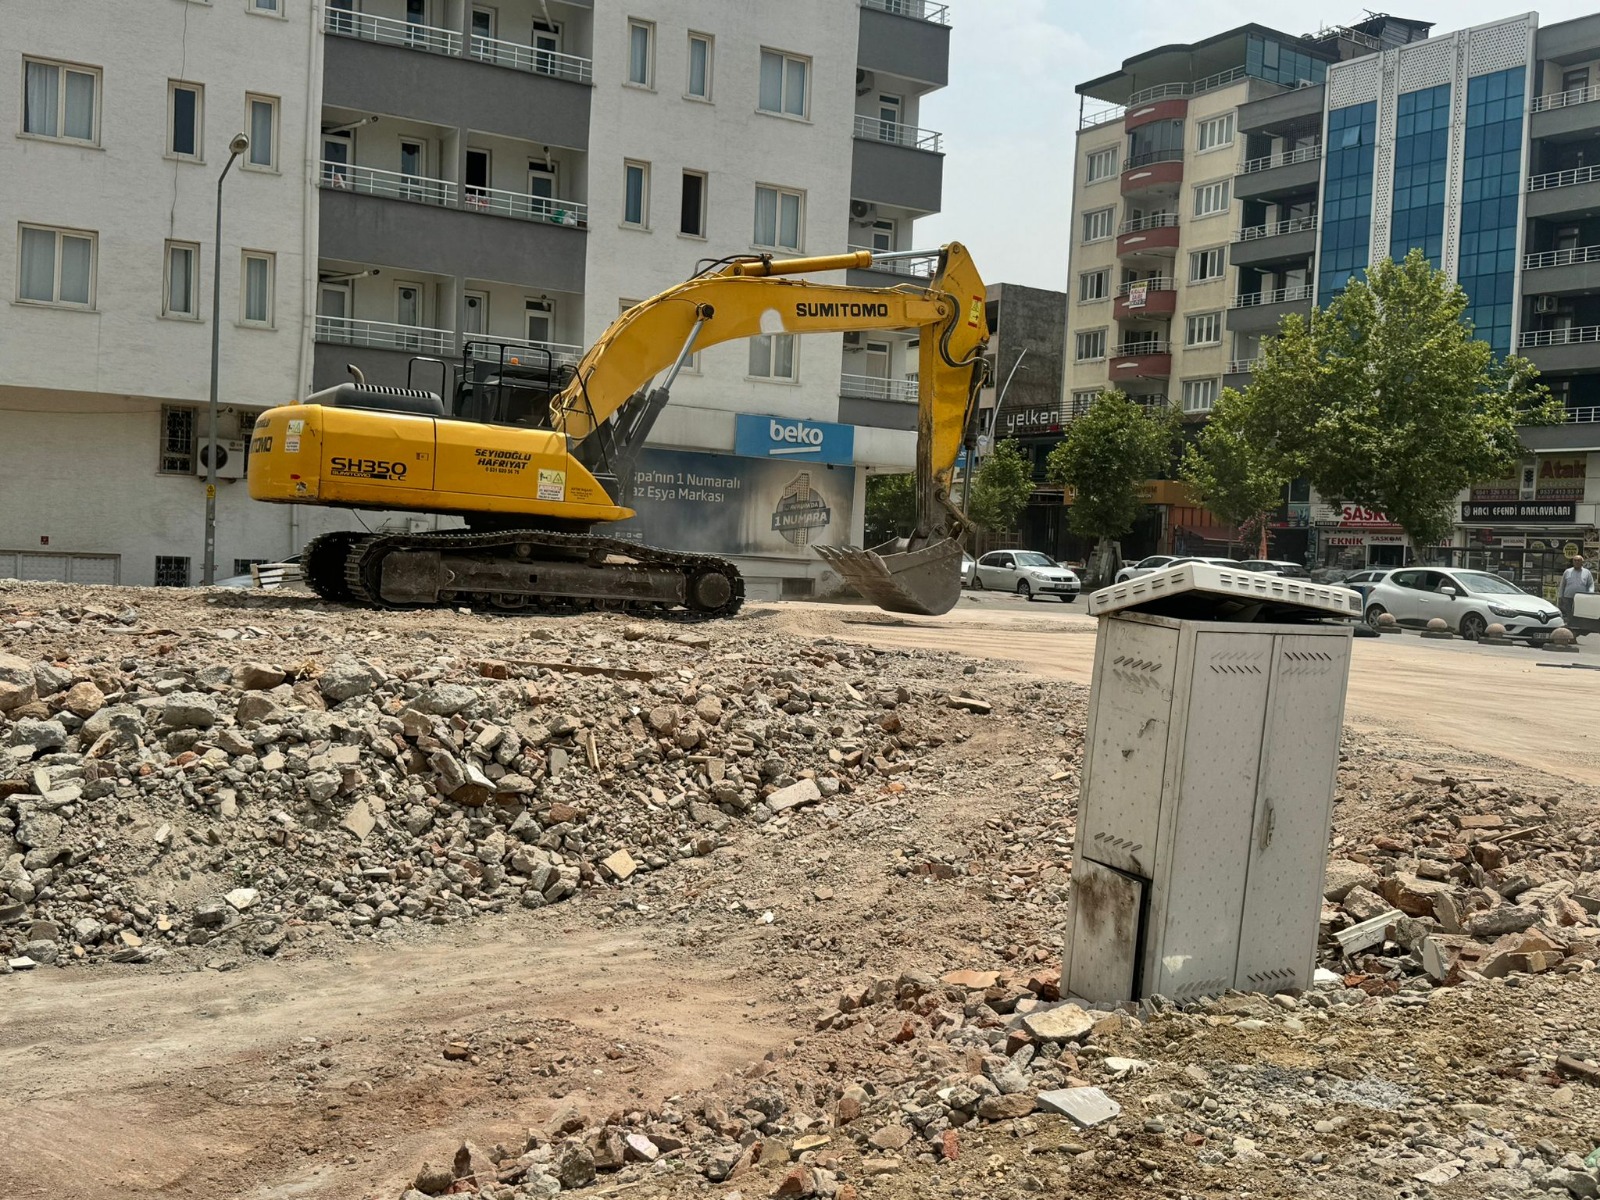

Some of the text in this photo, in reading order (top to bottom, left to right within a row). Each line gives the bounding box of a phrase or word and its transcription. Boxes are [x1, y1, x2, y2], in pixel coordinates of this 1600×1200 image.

[796, 302, 888, 317] SUMITOMO
[1006, 409, 1059, 433] yelken
[769, 419, 824, 445] beko
[331, 457, 407, 475] SH350
[1540, 460, 1586, 479] Atak
[634, 470, 740, 489] pa'nın 1 Numaralı
[647, 486, 675, 501] Eşya
[678, 488, 724, 503] Markası
[774, 511, 828, 526] 1 NUMARA
[1473, 505, 1571, 516] HACI EFENDİ BAKLAVALARI
